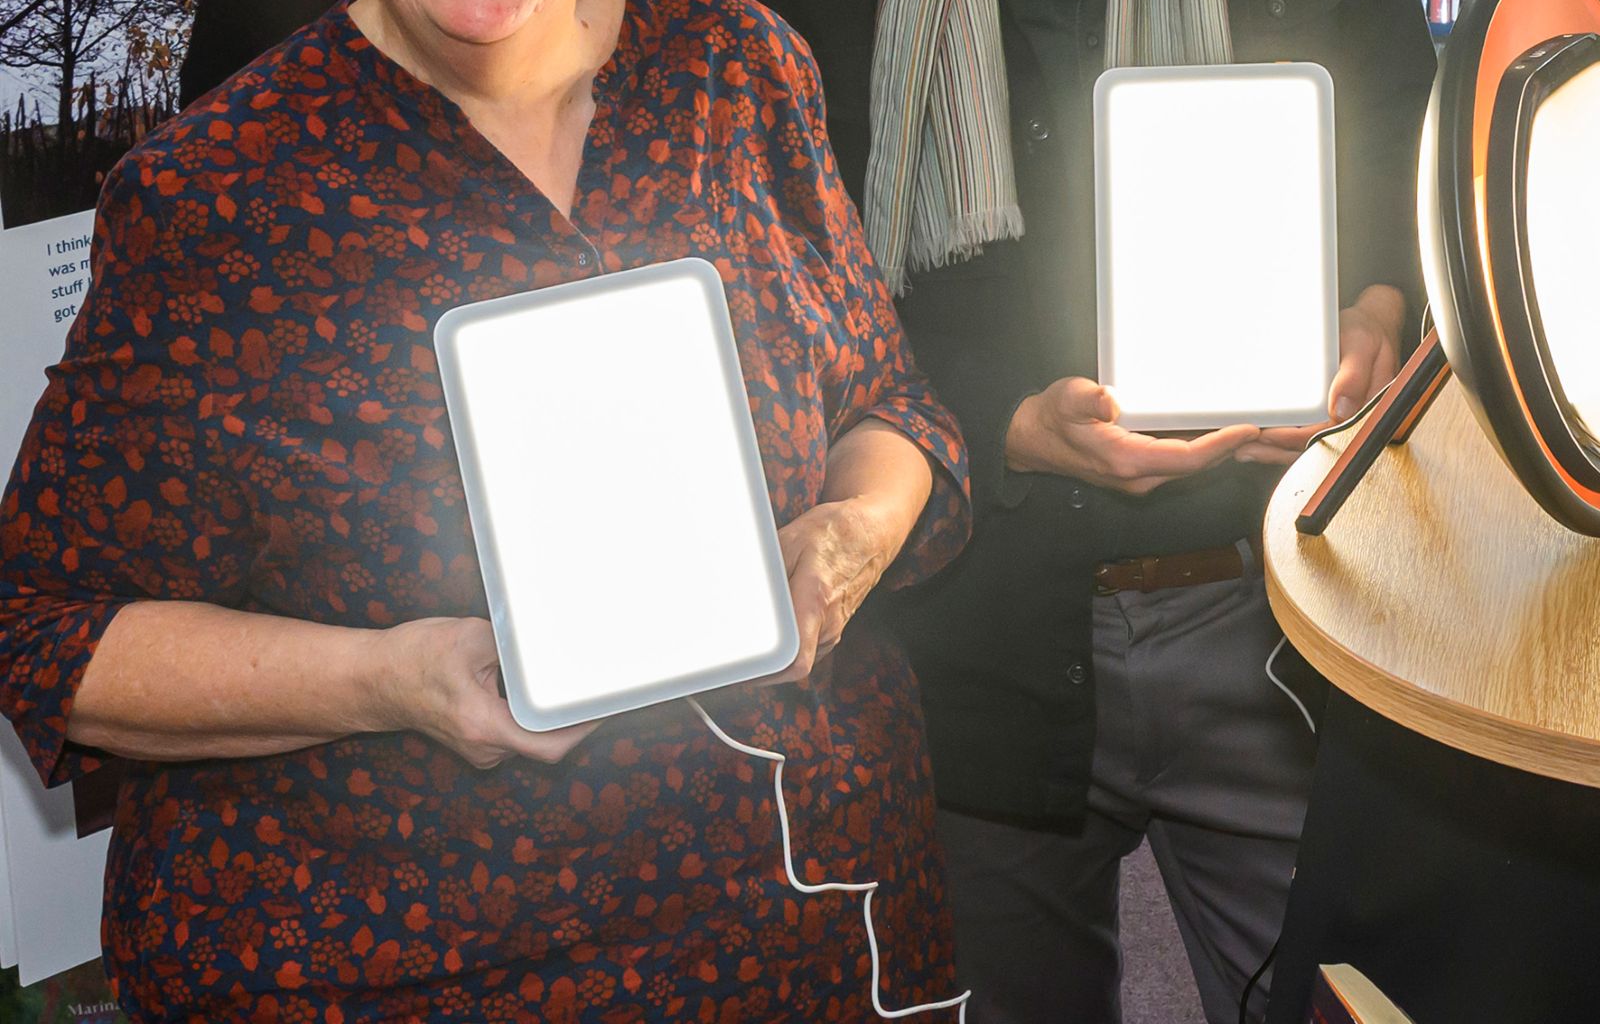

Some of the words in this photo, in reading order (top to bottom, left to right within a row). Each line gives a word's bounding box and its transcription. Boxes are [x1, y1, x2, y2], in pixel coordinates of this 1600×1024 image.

[47, 243, 51, 257] I
[56, 235, 92, 254] think
[49, 262, 76, 277] was
[51, 279, 84, 299] stuff
[54, 304, 77, 323] got
